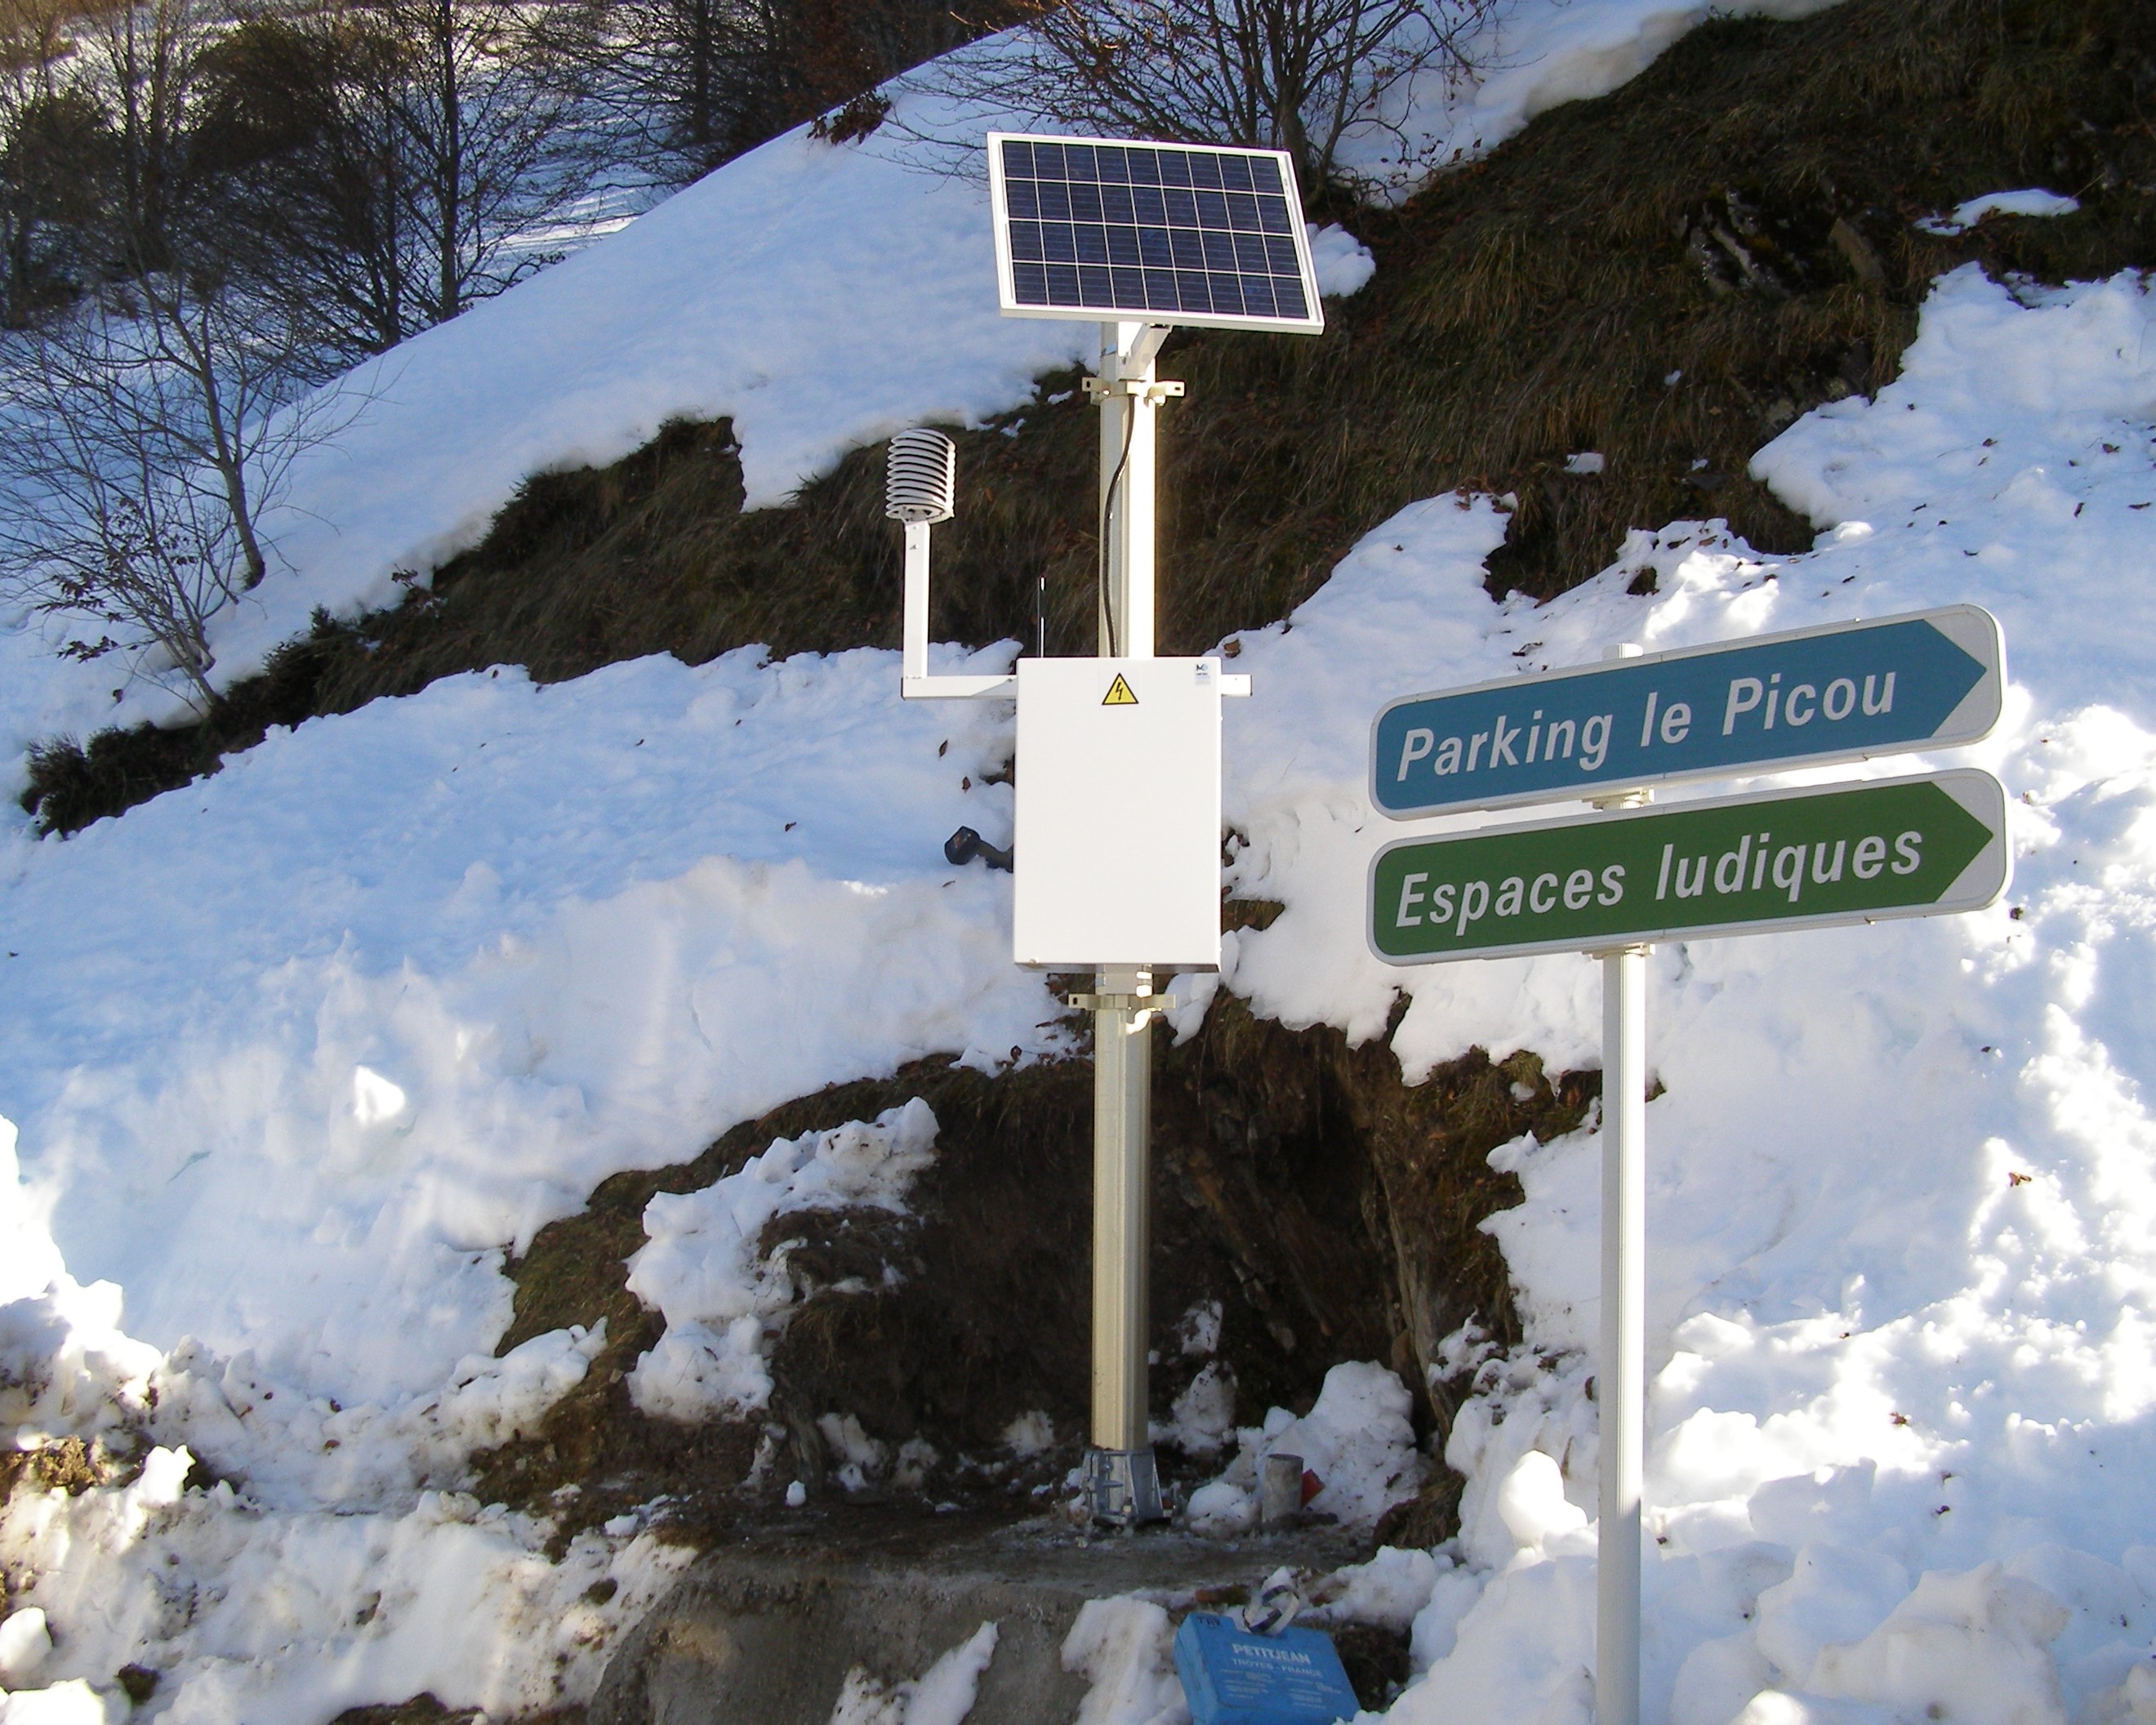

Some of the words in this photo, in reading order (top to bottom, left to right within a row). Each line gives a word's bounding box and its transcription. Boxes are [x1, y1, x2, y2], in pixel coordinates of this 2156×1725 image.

[1396, 710, 1614, 782] Parking
[1640, 692, 1691, 747] le
[1722, 671, 1896, 736] Picou
[1395, 864, 1626, 937] Espaces
[1655, 830, 1922, 903] ludiques
